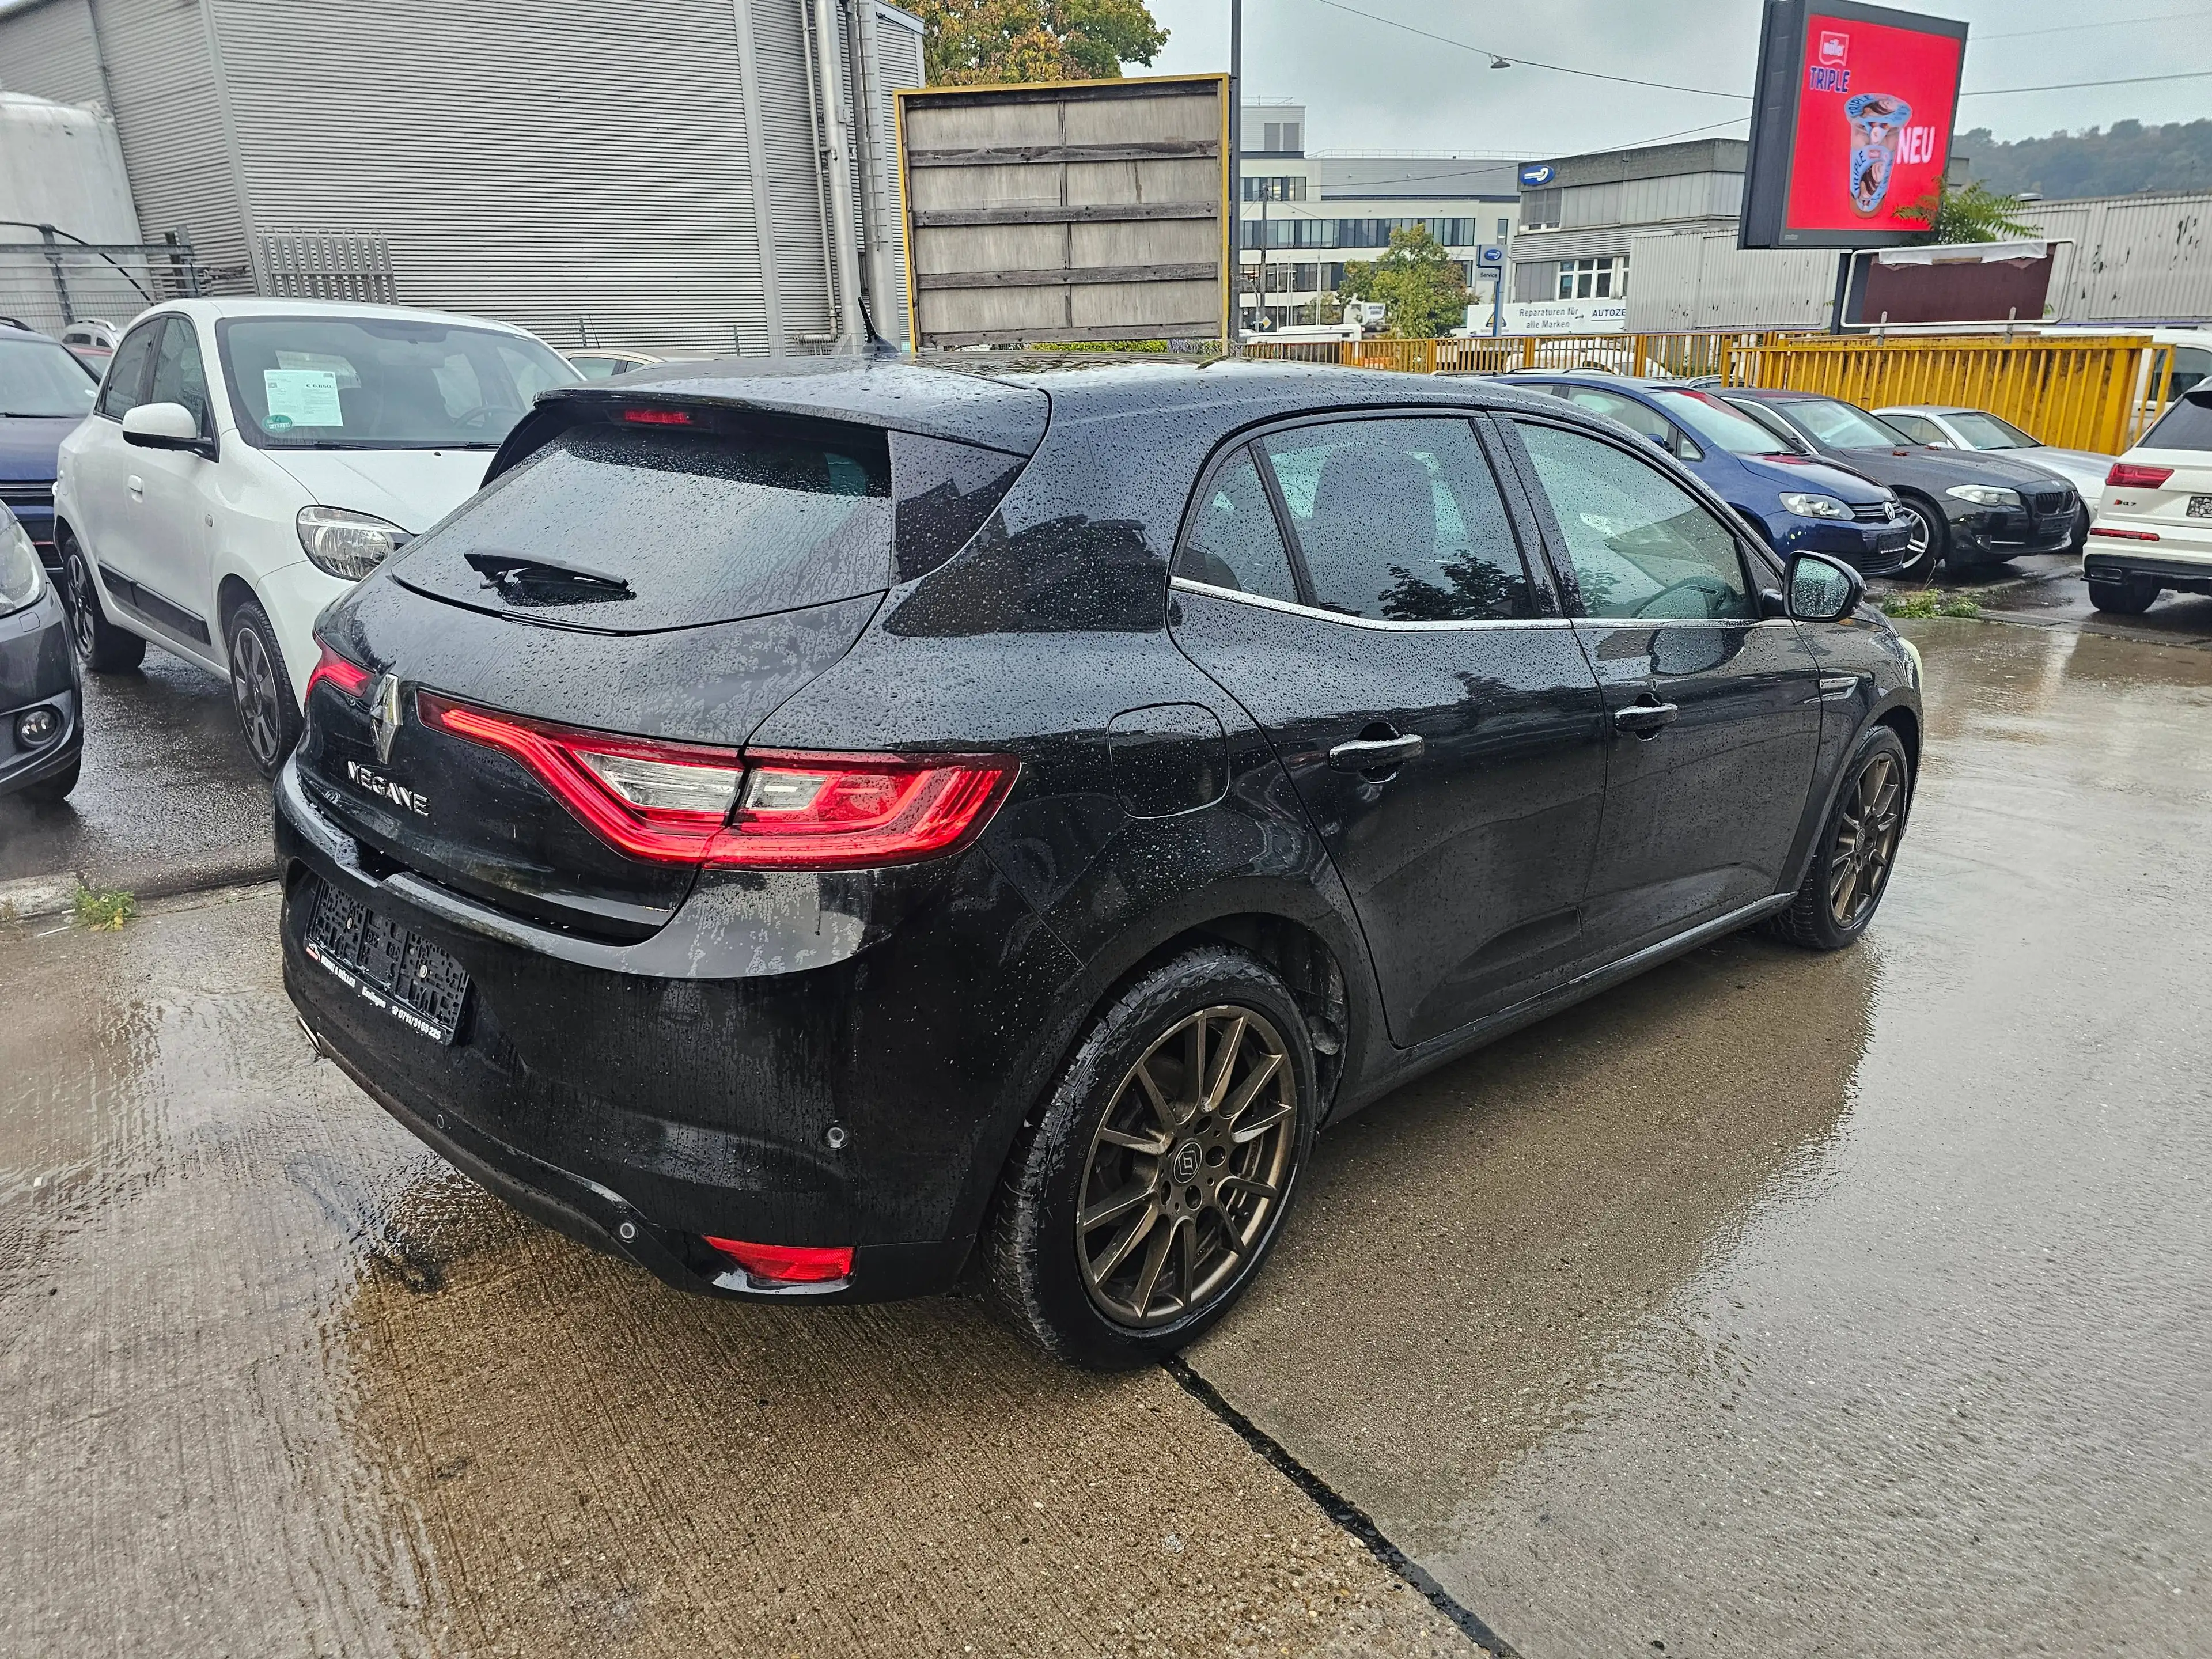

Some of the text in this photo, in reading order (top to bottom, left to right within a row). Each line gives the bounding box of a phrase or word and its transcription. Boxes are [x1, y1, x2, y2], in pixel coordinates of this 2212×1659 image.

[1809, 65, 1850, 94] TRIPLE
[1896, 126, 1936, 165] NEU
[1520, 307, 1578, 317] Reparaturen für
[1542, 320, 1570, 328] Marken
[348, 761, 431, 817] MEGANE
